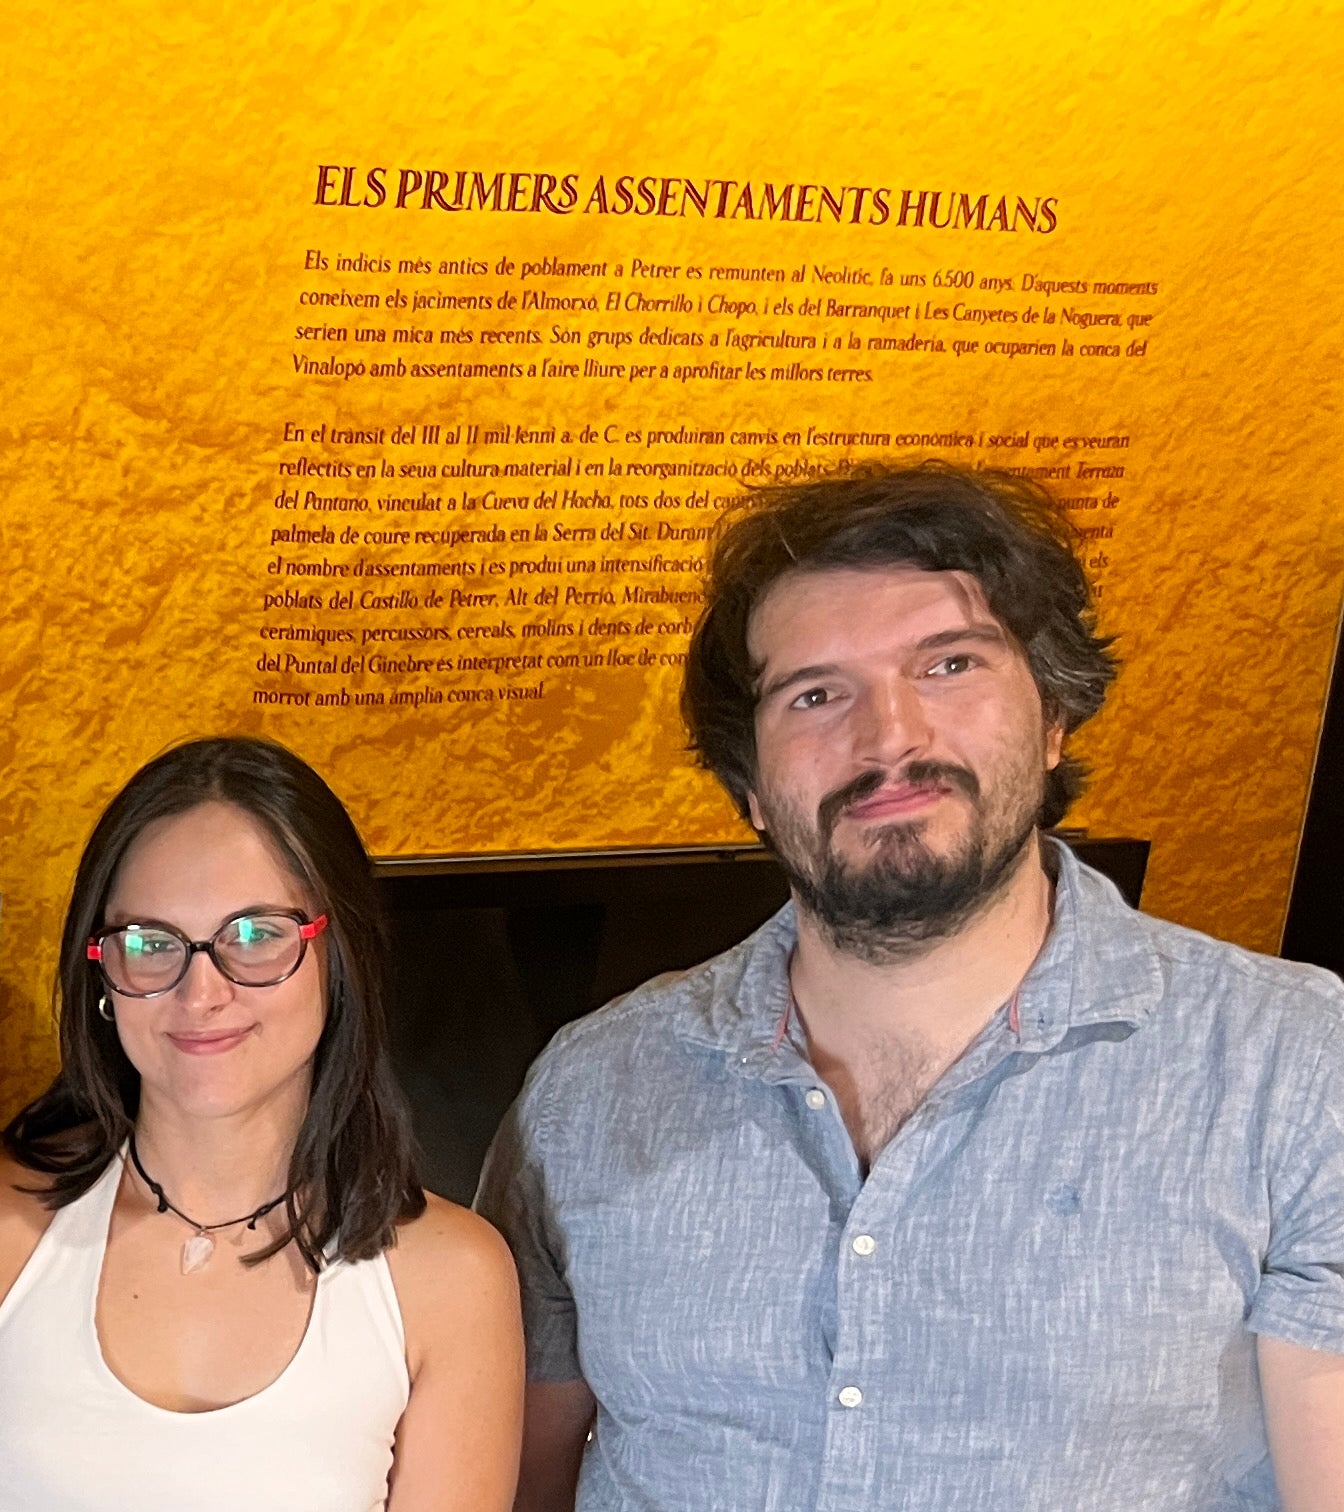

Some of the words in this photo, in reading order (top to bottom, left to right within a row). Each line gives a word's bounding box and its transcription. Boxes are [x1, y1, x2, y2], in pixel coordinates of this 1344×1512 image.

[313, 164, 387, 209] ELS
[395, 168, 579, 215] PRIMERS
[583, 174, 892, 227] ASSENTAMENTS
[896, 188, 1059, 235] HUMANS
[303, 249, 329, 272] Els
[336, 251, 392, 274] indicis
[438, 257, 489, 277] antics
[495, 255, 516, 277] de
[520, 255, 608, 281] poblament
[613, 263, 624, 278] a
[630, 257, 682, 280] Petrer
[685, 265, 703, 280] es
[708, 266, 786, 284] remunten
[791, 262, 806, 283] al
[879, 266, 894, 286] fa
[900, 273, 927, 287] uns
[369, 356, 407, 379] amb
[410, 361, 524, 379] assentaments
[526, 363, 537, 379] a
[583, 358, 626, 379] lliure
[628, 364, 658, 384] per
[659, 364, 669, 380] a
[672, 359, 743, 385] aprofitar
[745, 360, 767, 381] les
[770, 362, 824, 382] millors
